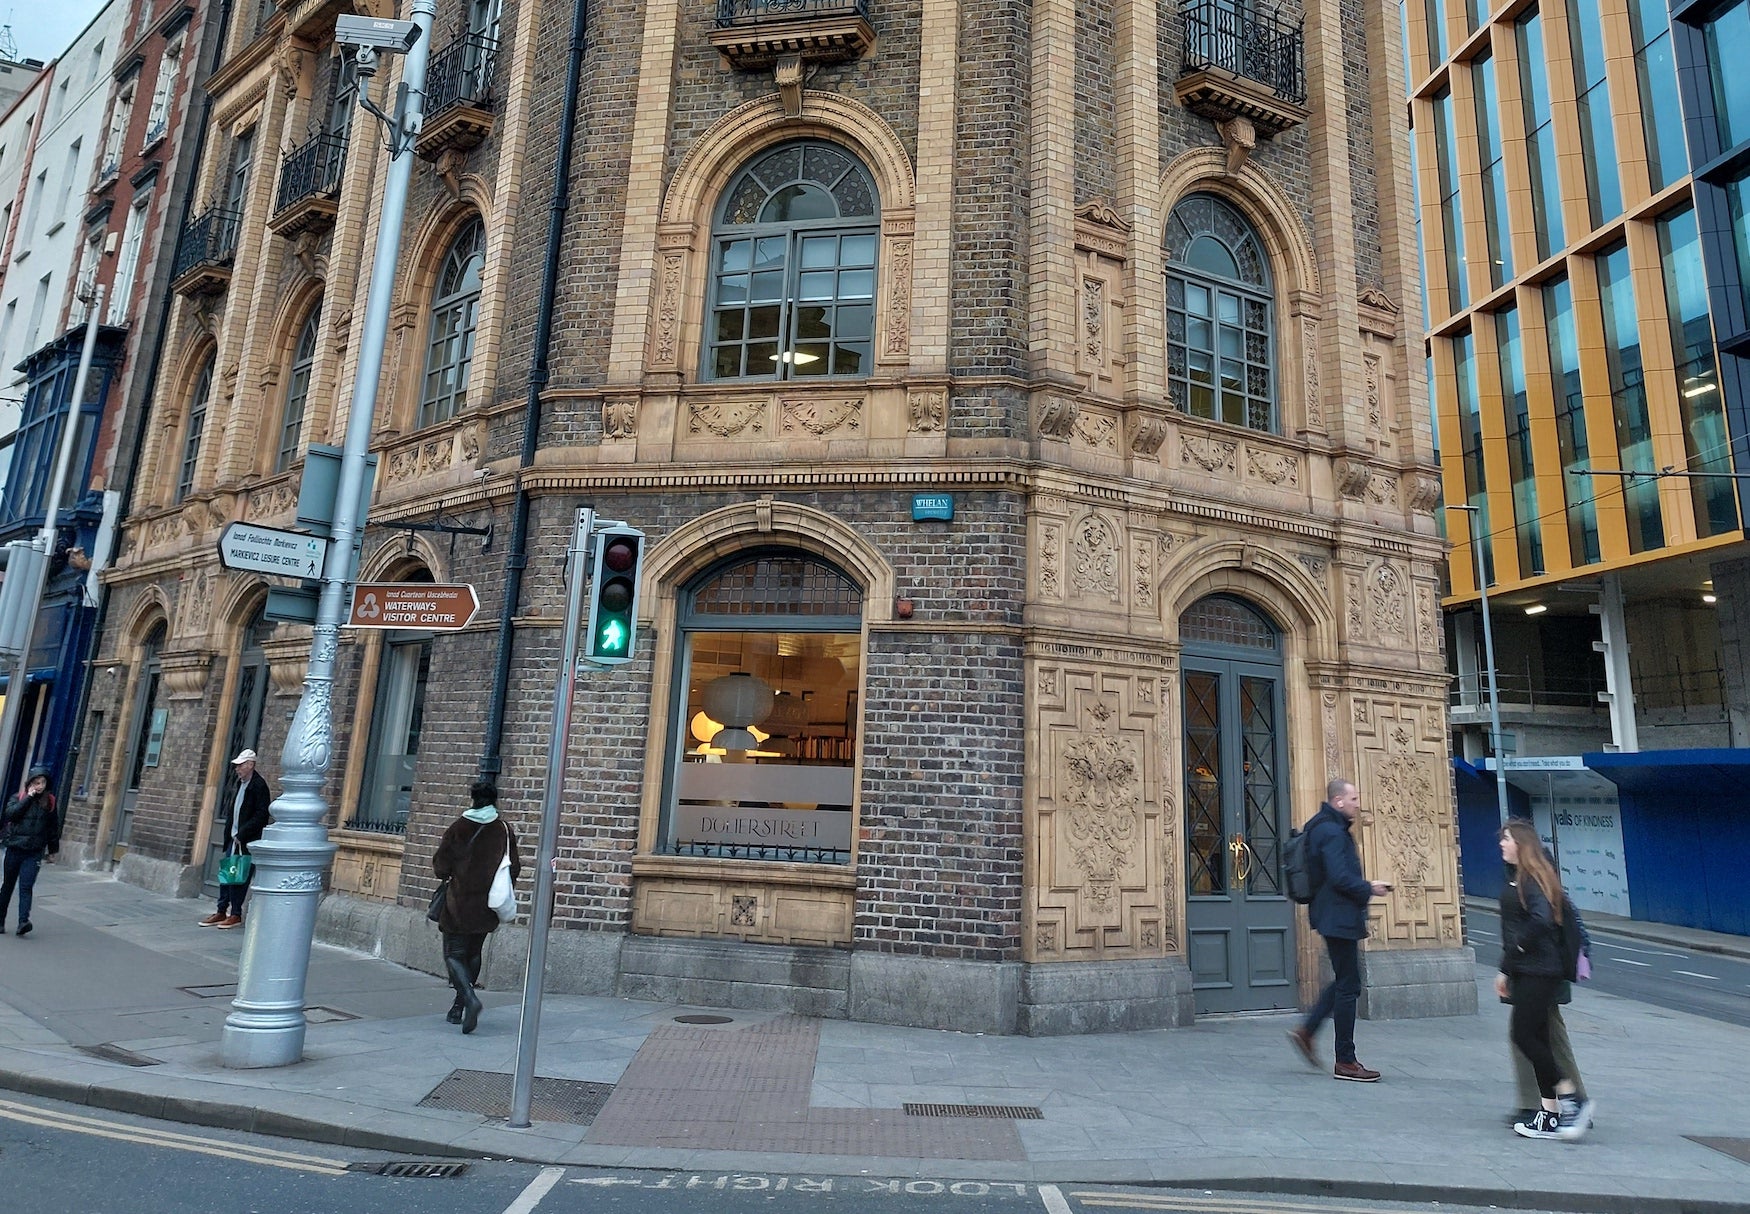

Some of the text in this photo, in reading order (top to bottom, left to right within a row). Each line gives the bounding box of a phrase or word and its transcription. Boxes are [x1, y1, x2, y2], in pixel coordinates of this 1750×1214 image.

[915, 498, 948, 507] WHELAN
[230, 549, 260, 561] MARKIEVICZ
[260, 553, 281, 564] LEISURE
[281, 556, 300, 567] CENTRE
[384, 601, 437, 611] WATERWAYS
[382, 613, 456, 623] VISITOR CENTRE
[1574, 814, 1582, 826] OF
[1583, 815, 1614, 828] KINDNESS
[862, 1179, 1027, 1196] LOOK
